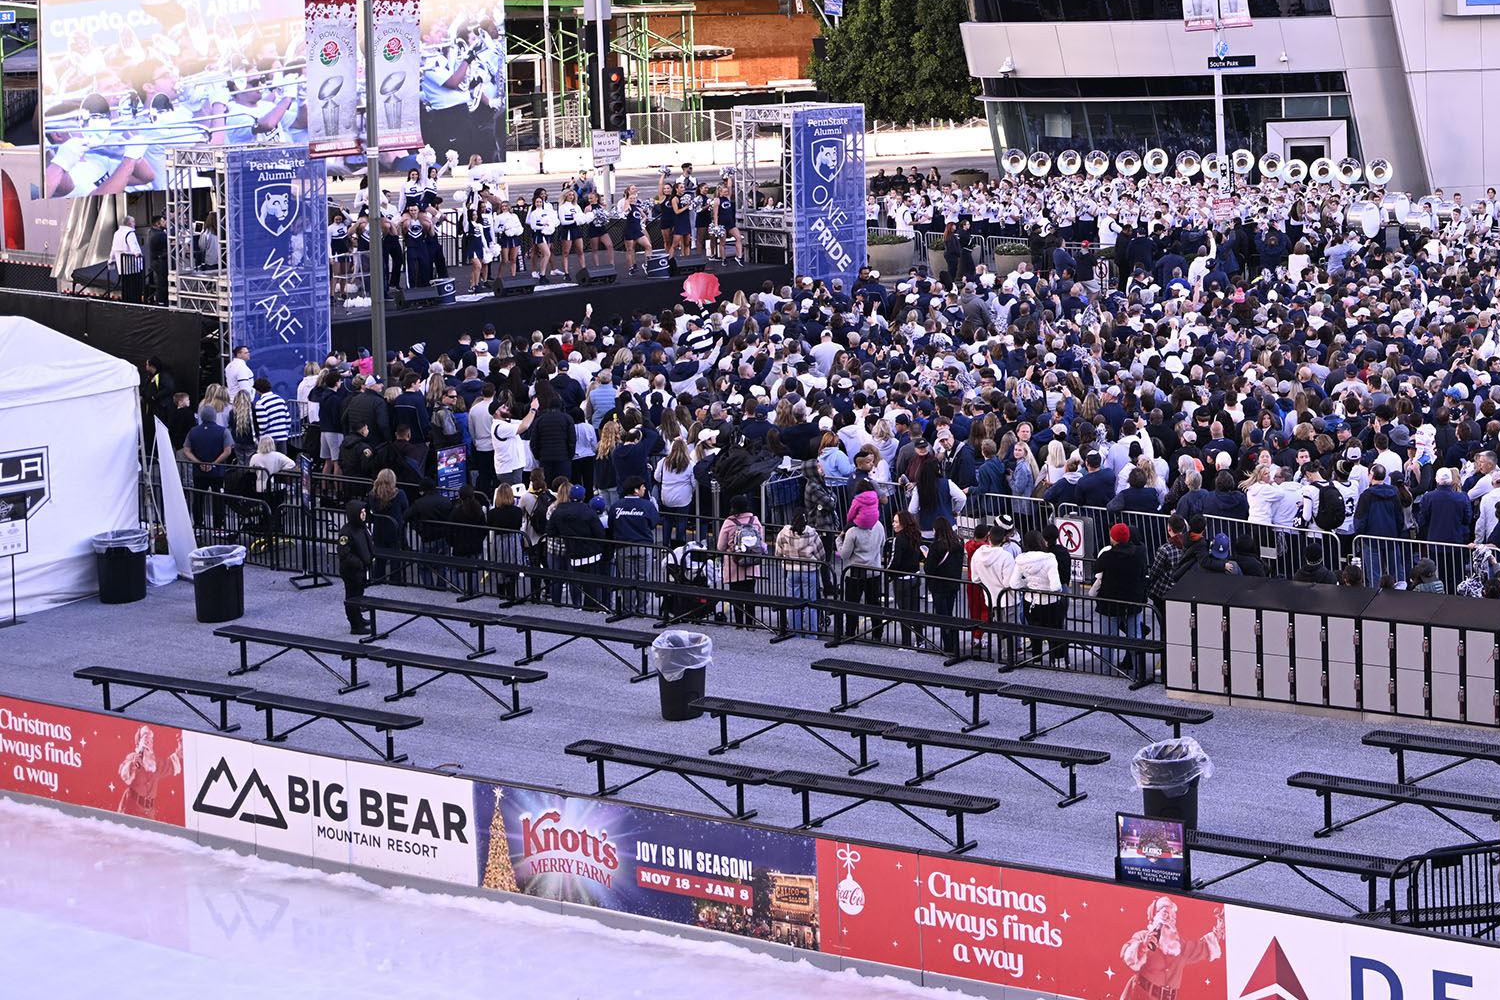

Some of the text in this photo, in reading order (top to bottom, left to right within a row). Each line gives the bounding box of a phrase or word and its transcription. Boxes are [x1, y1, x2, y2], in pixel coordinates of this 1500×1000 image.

[319, 31, 340, 40] BOWL
[383, 27, 403, 36] BOWL
[404, 33, 417, 54] GAME
[807, 117, 848, 127] PennState
[814, 126, 842, 136] Alumni
[249, 159, 305, 172] PennState
[258, 170, 296, 182] Alumni
[812, 185, 848, 231] ONE
[810, 217, 852, 272] PRIDE
[263, 248, 303, 296] WE
[255, 295, 303, 343] ARE
[615, 507, 644, 520] Yankees
[0, 707, 73, 742] Christmas
[0, 735, 82, 768] lways finds
[14, 766, 59, 792] a way
[288, 774, 469, 844] BIG BEAR
[317, 825, 439, 859] MOUNTAIN RESORT
[519, 810, 620, 871] Knott's
[1148, 847, 1162, 856] KINGS
[529, 858, 613, 890] MERRY FARM
[635, 840, 754, 882] JOY IS IN SEASON!
[1152, 868, 1181, 877] PHOTOGRAPHY
[640, 871, 670, 887] NOV
[675, 877, 691, 891] 18
[705, 882, 735, 899] JAN
[739, 888, 750, 901] 8
[775, 886, 800, 898] CALICO
[927, 871, 1047, 915] Christmas
[914, 903, 1063, 949] always finds
[953, 943, 1025, 978] a way
